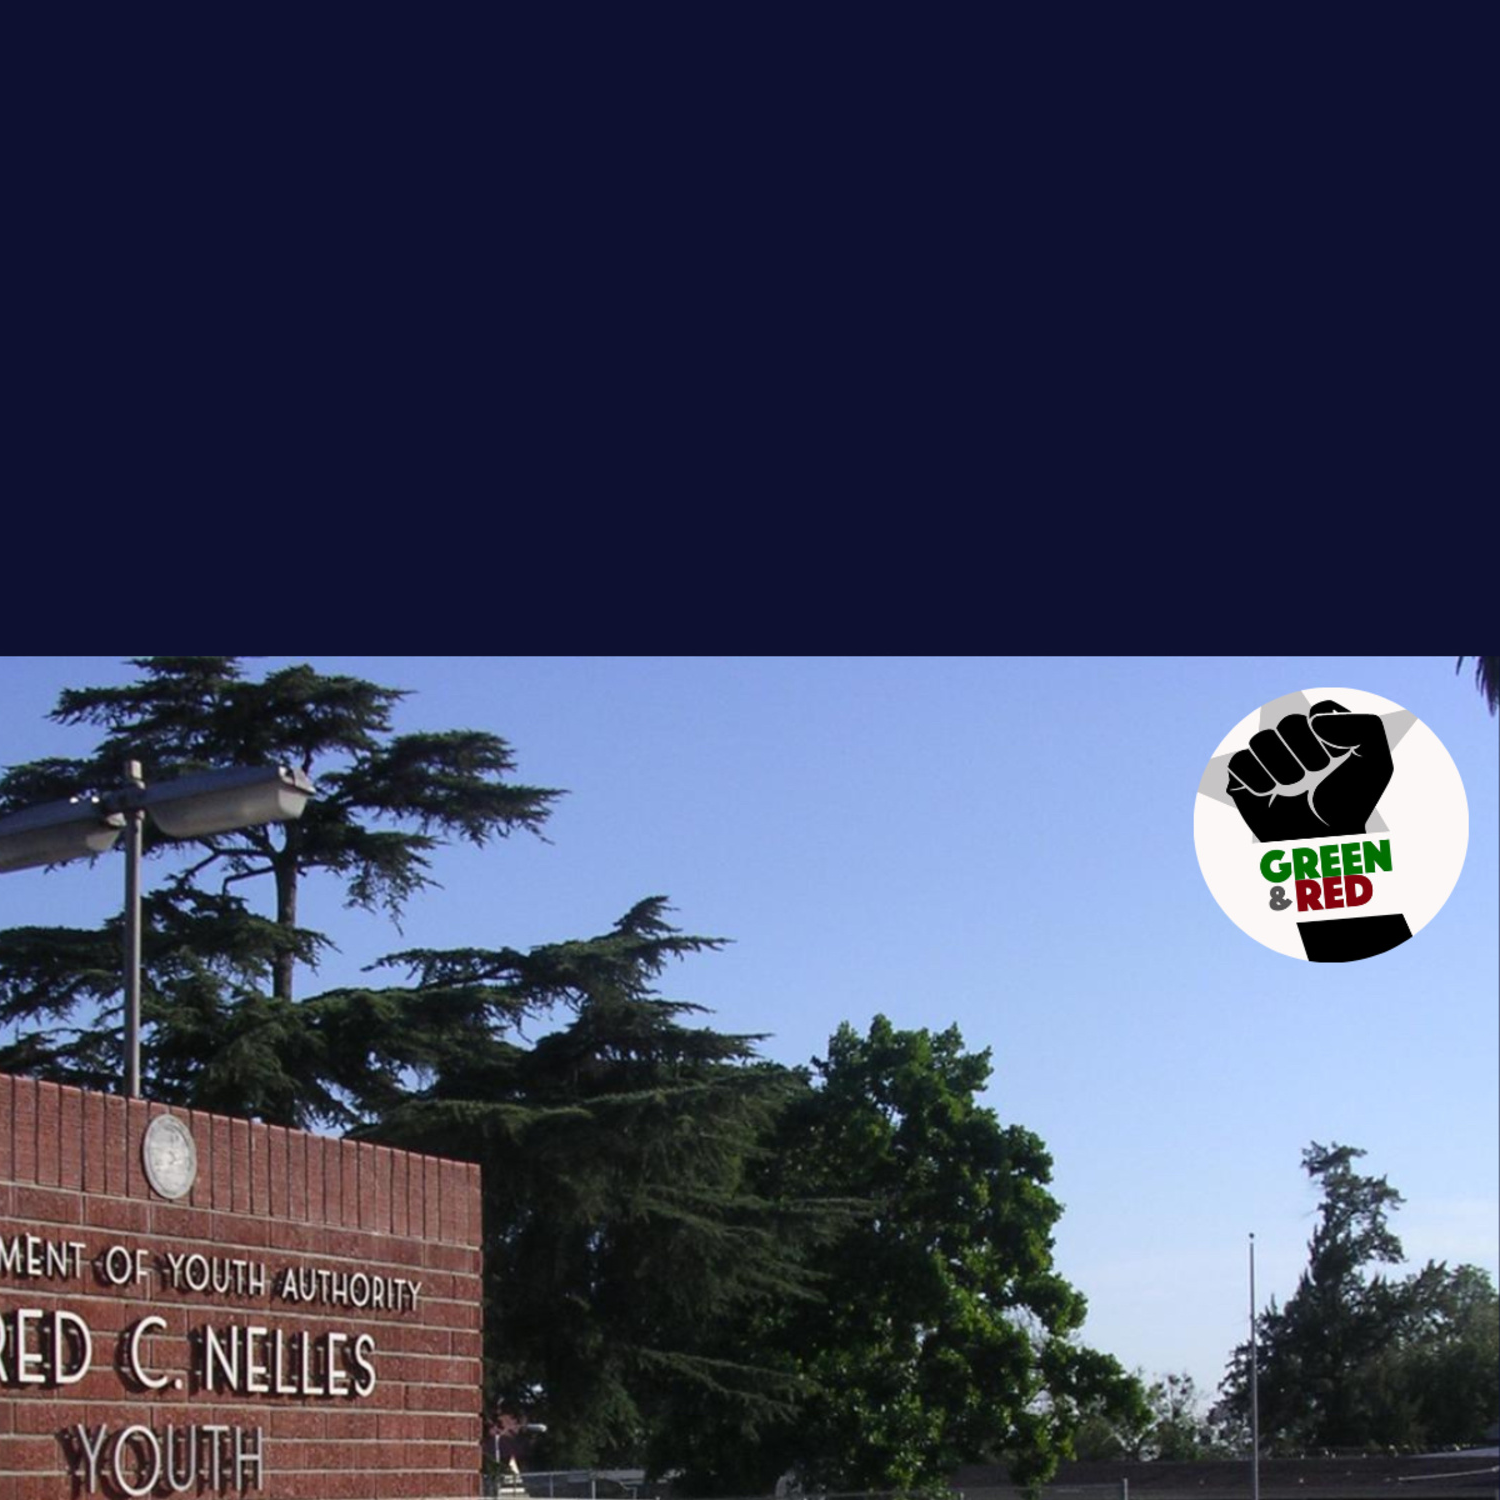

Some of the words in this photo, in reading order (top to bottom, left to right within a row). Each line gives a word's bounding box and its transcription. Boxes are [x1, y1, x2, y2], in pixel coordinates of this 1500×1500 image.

[106, 1246, 149, 1284] OF
[168, 1253, 265, 1296] YOUTH
[282, 1268, 422, 1311] AUTHORITY
[131, 1316, 184, 1390] C.
[206, 1325, 376, 1397] NELLES
[77, 1423, 263, 1497] YOUTH
